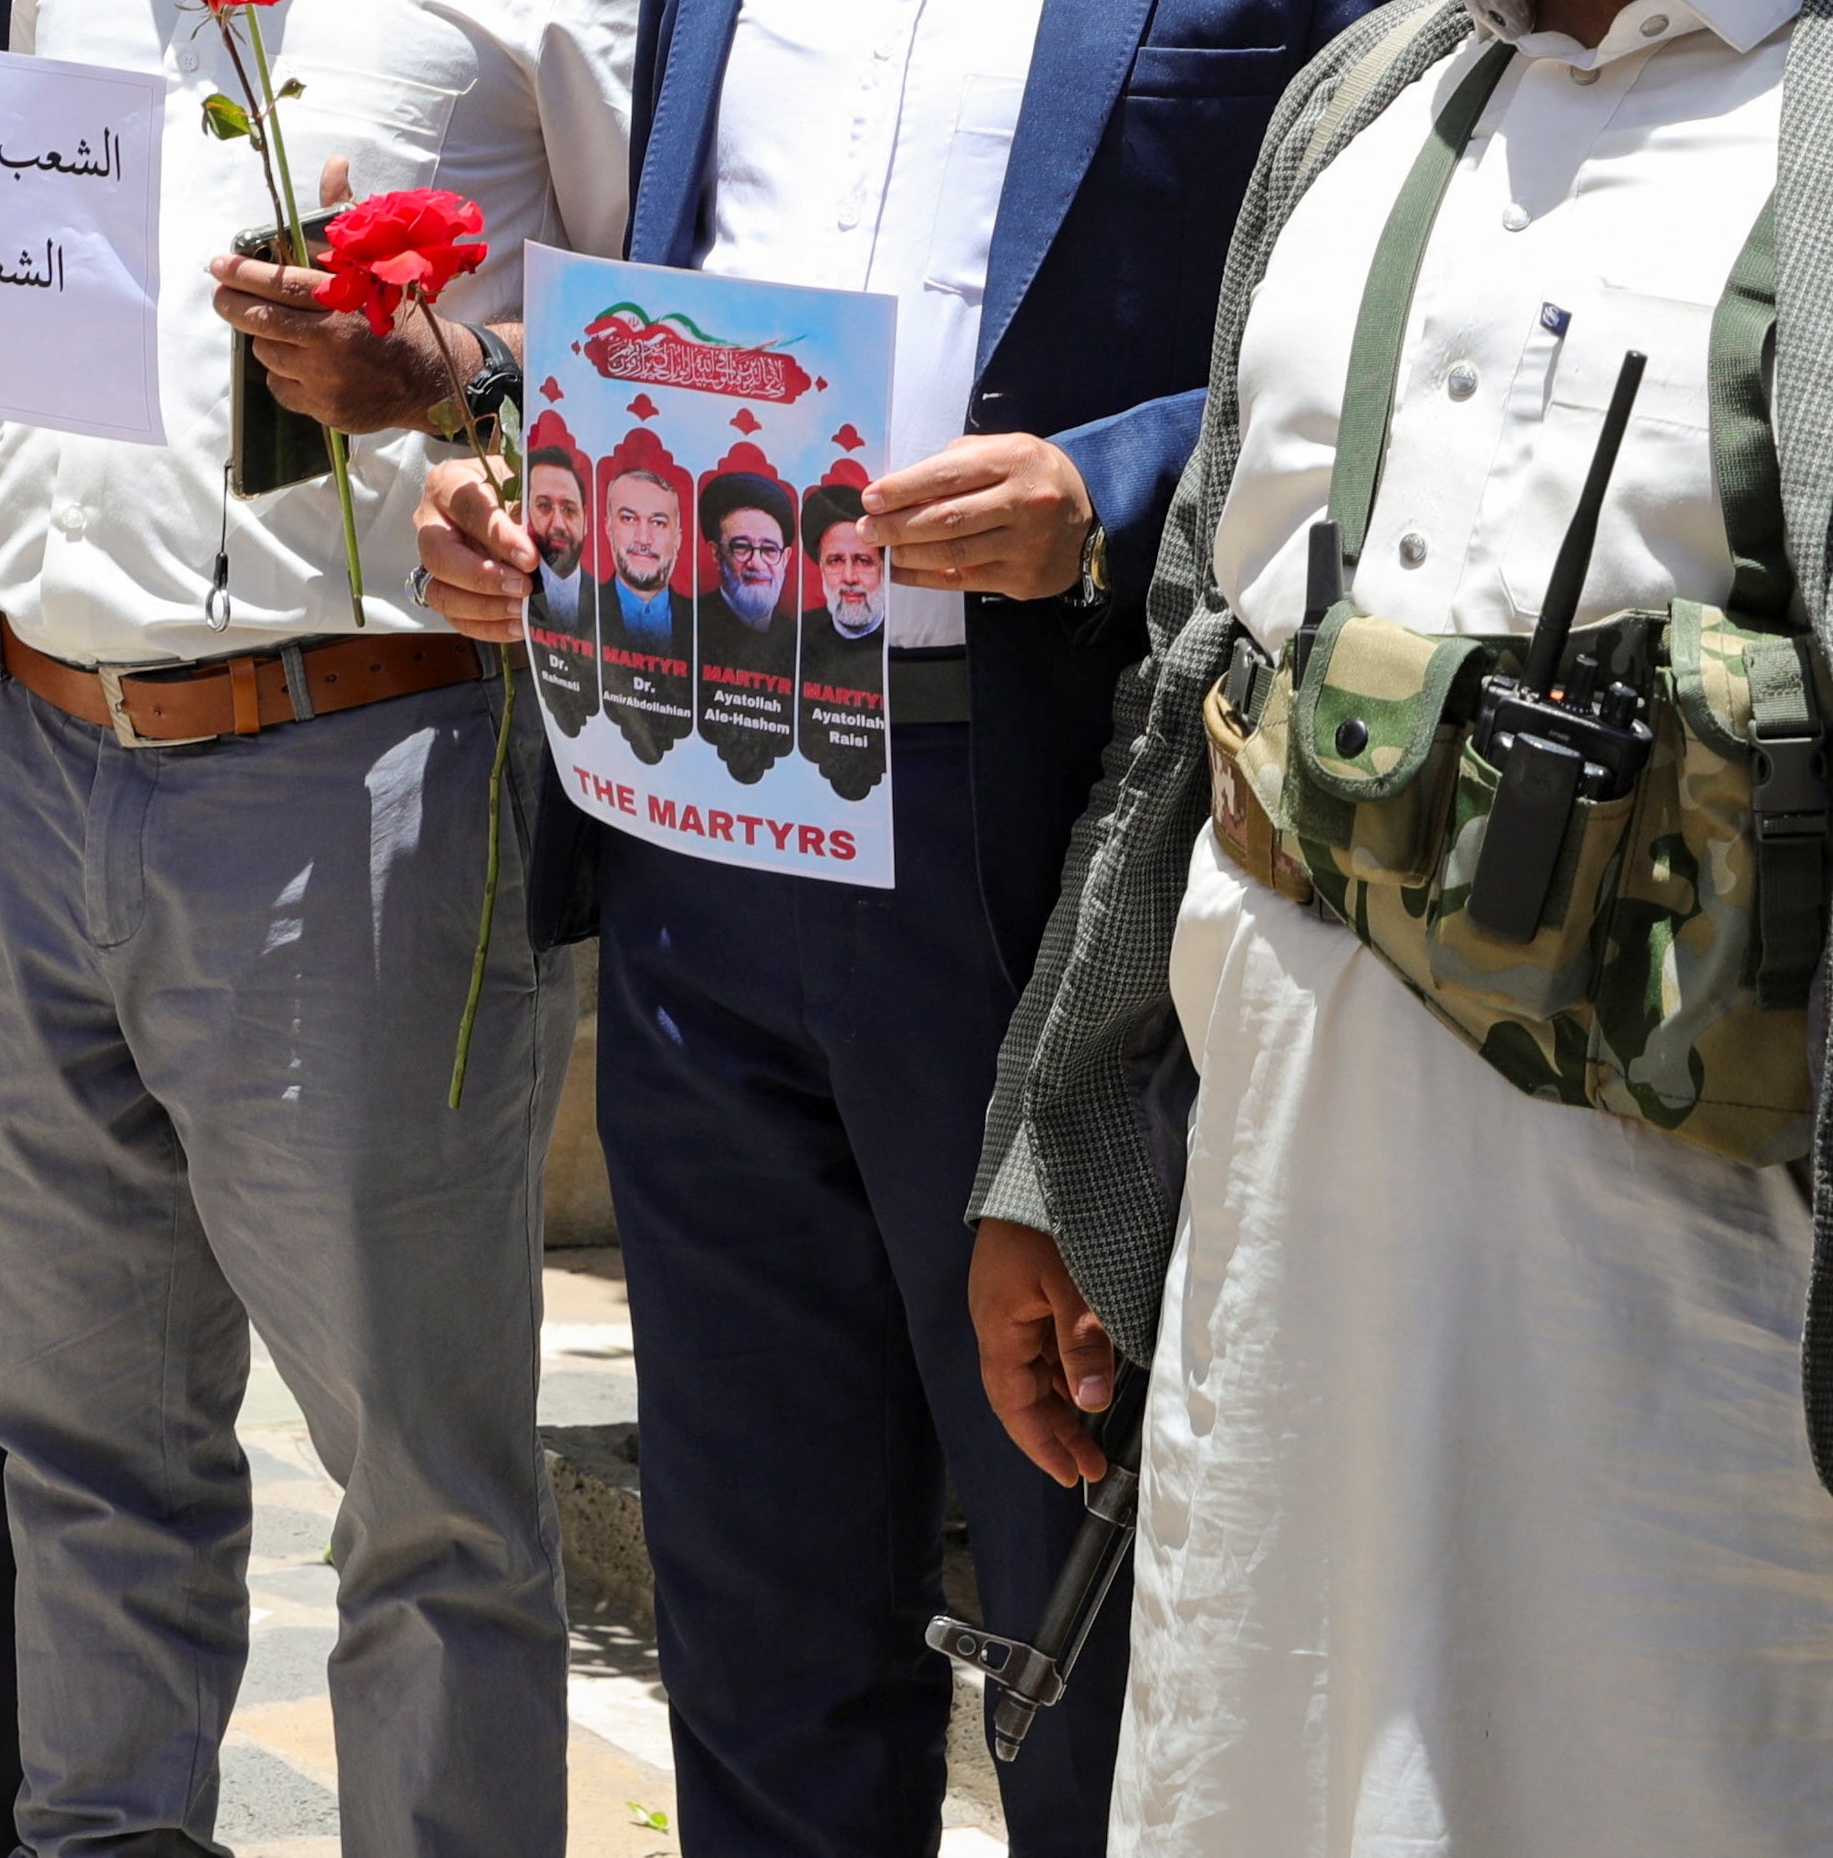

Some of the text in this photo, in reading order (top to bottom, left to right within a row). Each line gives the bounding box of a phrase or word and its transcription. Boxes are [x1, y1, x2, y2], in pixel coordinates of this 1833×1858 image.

[549, 654, 569, 672] Dr.
[602, 645, 688, 678] MARTYR
[541, 669, 581, 693] Rahmati
[633, 676, 656, 693] Dr.
[702, 664, 793, 696] MARTYR
[603, 690, 692, 719] AmirAbdollahian
[713, 689, 782, 713] Ayatollah
[803, 681, 884, 711] MARTY
[704, 708, 790, 736] Ale-Hashem
[811, 707, 885, 731] Ayatollah
[829, 730, 869, 748] Raisi
[572, 764, 858, 861] THE MARTYRS
